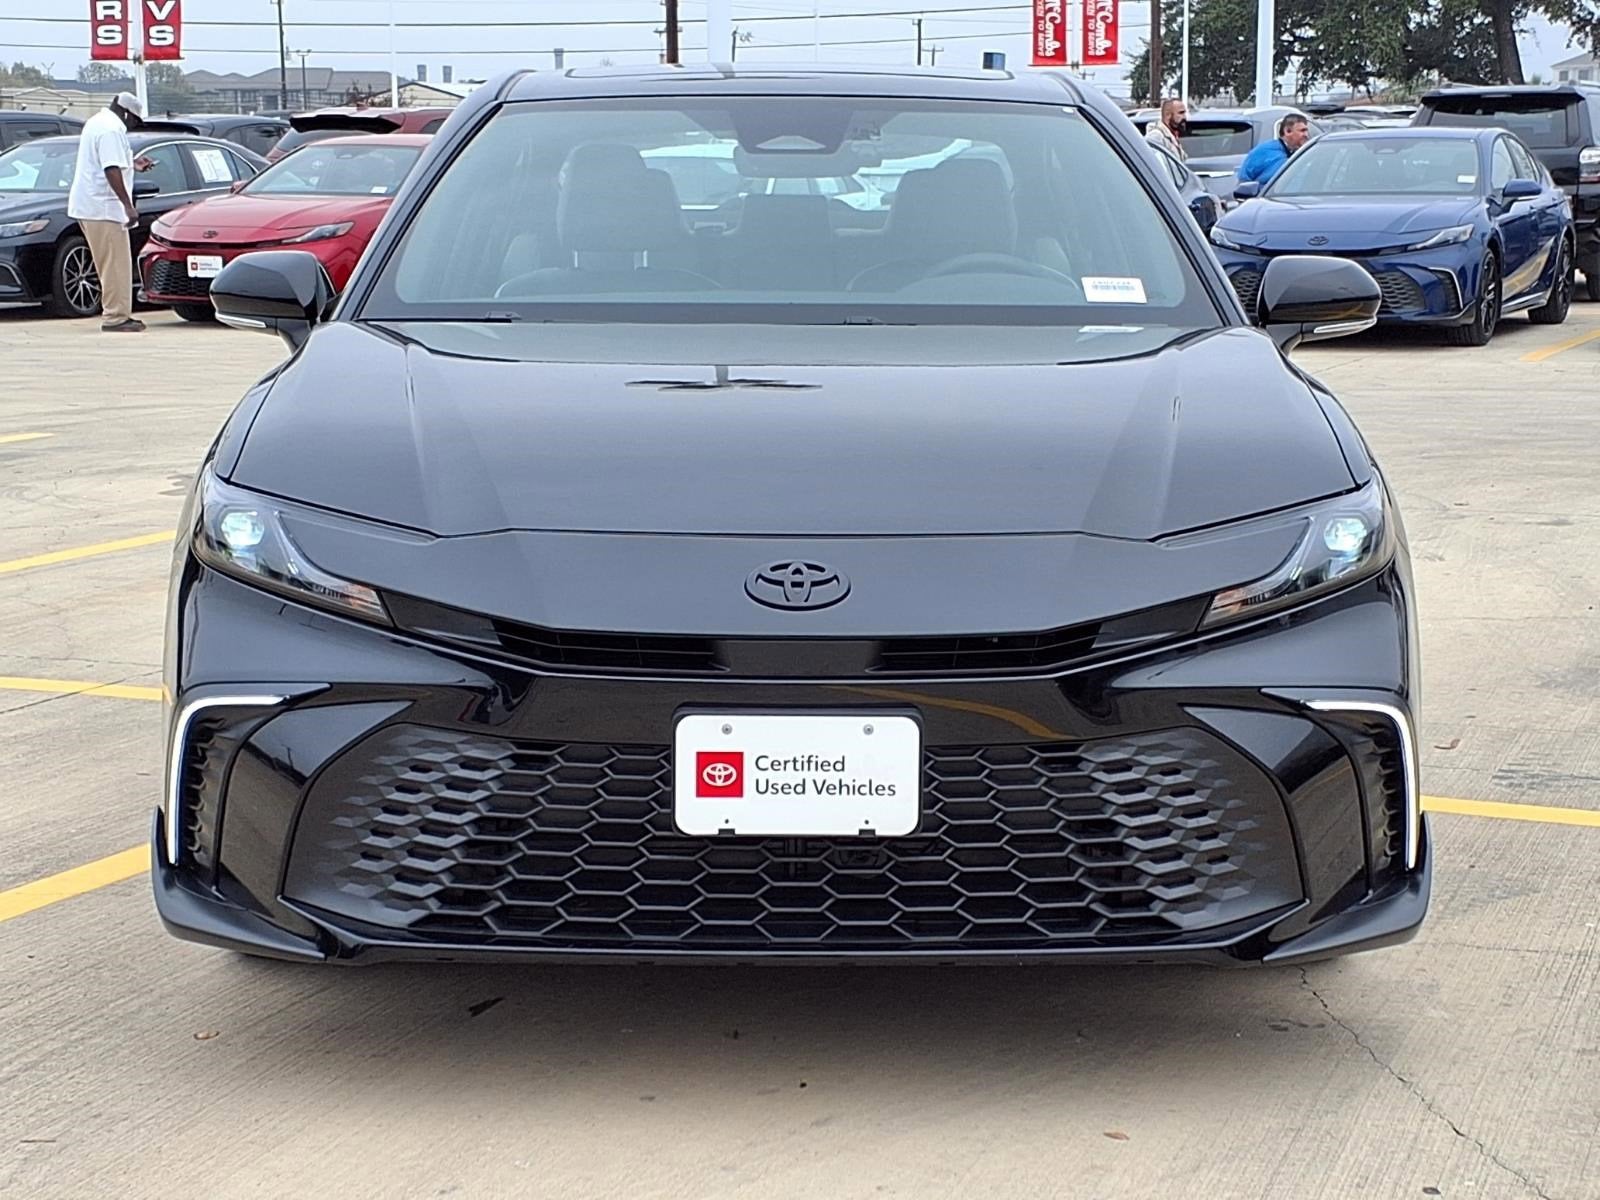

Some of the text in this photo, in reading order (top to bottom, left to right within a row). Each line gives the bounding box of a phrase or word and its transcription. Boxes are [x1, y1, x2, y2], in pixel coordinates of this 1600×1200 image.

[755, 755, 846, 773] Certified
[755, 778, 897, 797] Used Vehicles
